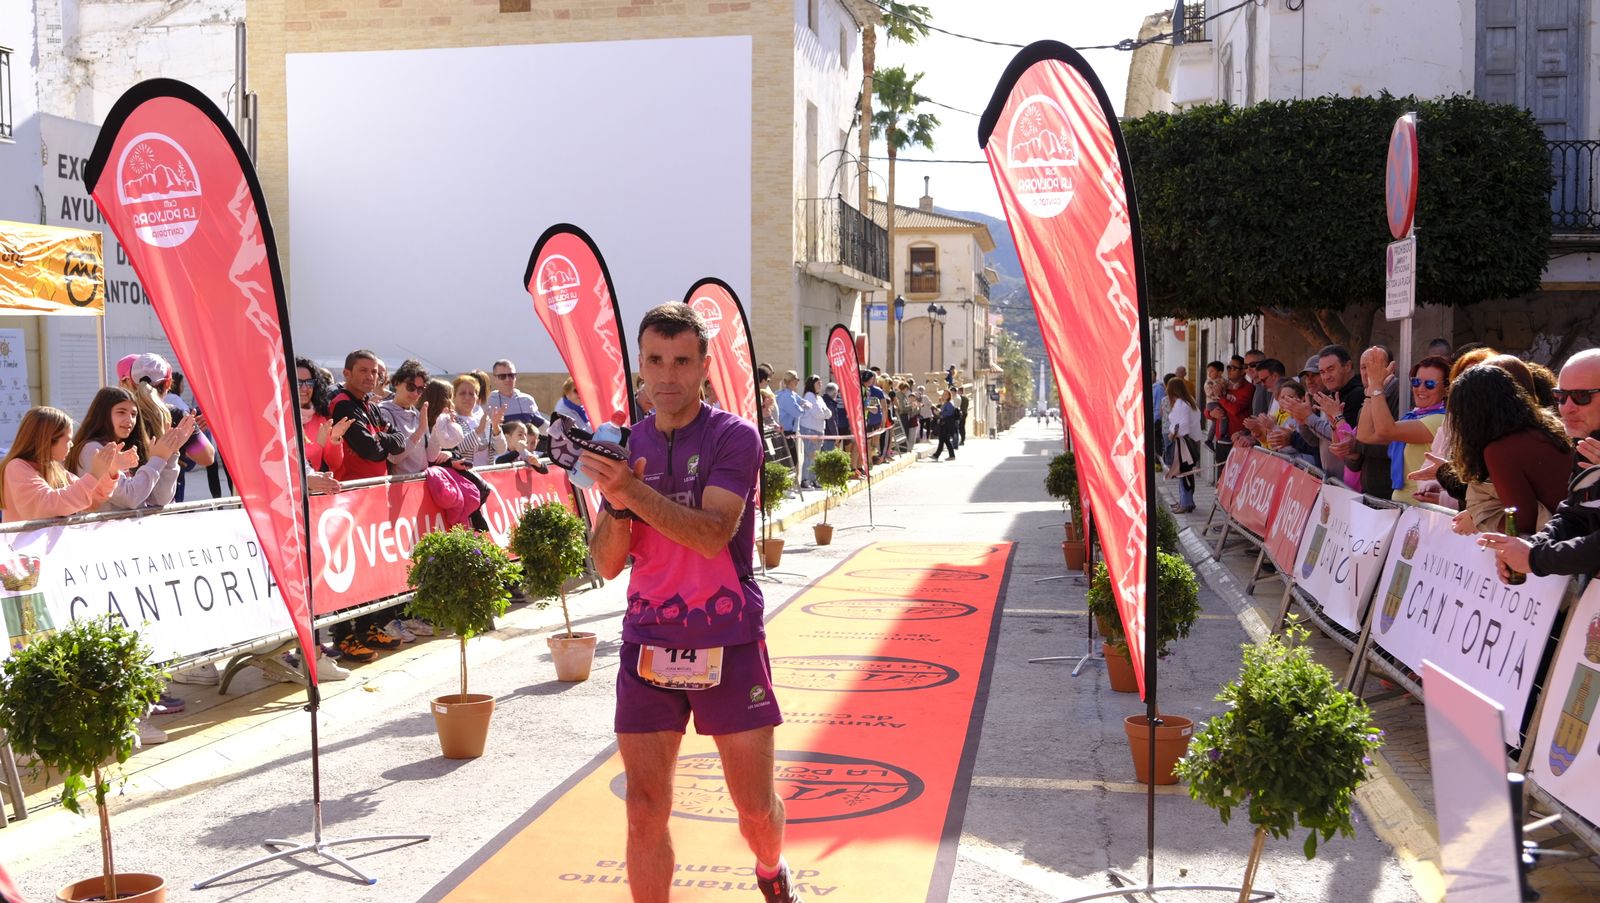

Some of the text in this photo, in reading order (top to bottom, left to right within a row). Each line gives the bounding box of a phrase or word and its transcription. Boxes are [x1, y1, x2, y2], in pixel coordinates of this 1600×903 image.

[117, 242, 132, 266] D
[64, 541, 259, 587] AYUNTAMIENTO D
[1423, 552, 1542, 626] AYUNTAMIENTO DE
[1406, 580, 1528, 691] CANTORIA
[664, 647, 697, 663] 14
[677, 763, 889, 778] LA POLRA
[595, 859, 758, 877] Cantia
[557, 871, 839, 897] Ayntamnto
